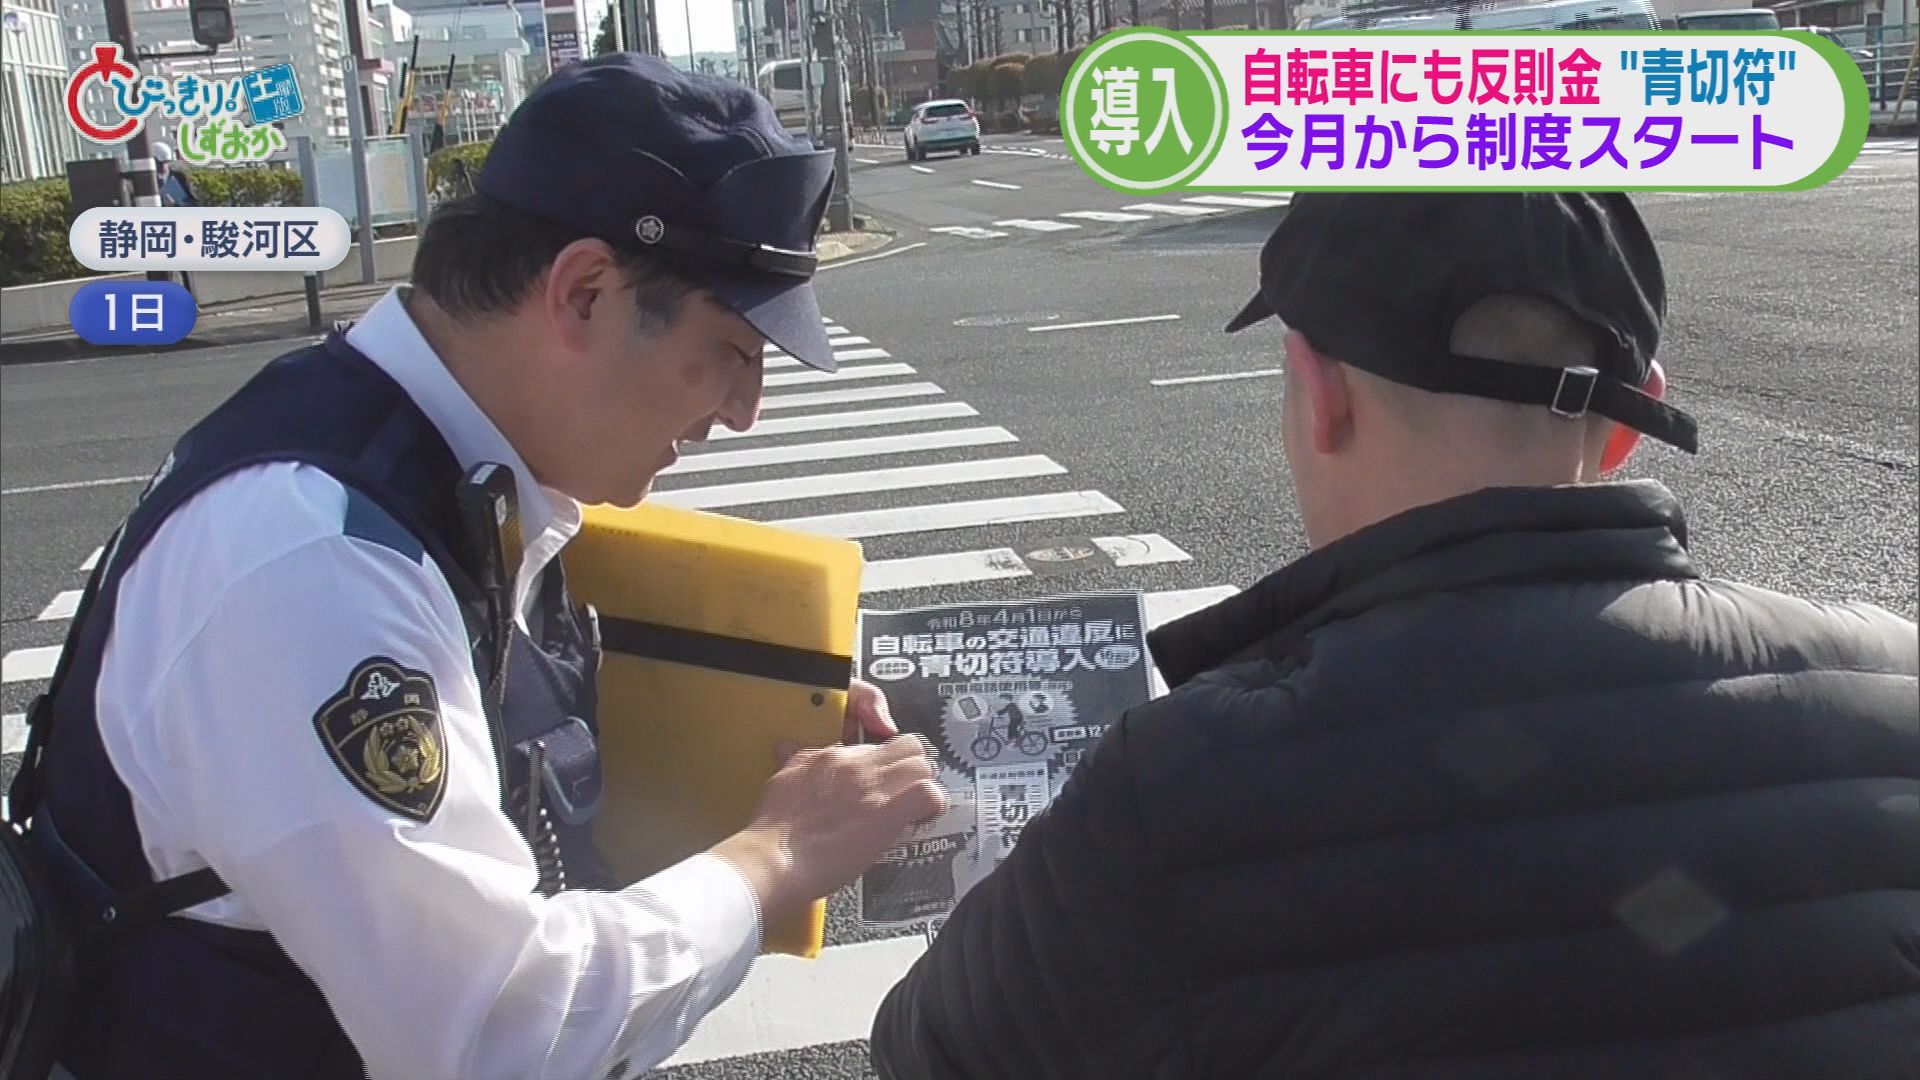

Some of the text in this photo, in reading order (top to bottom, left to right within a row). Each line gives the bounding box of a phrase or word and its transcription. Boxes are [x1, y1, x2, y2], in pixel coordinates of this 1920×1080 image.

[927, 607, 1082, 629] 令和8年4月1日から
[872, 620, 1135, 656] 自転車の交通違反に
[919, 647, 1096, 678] 青切符導入
